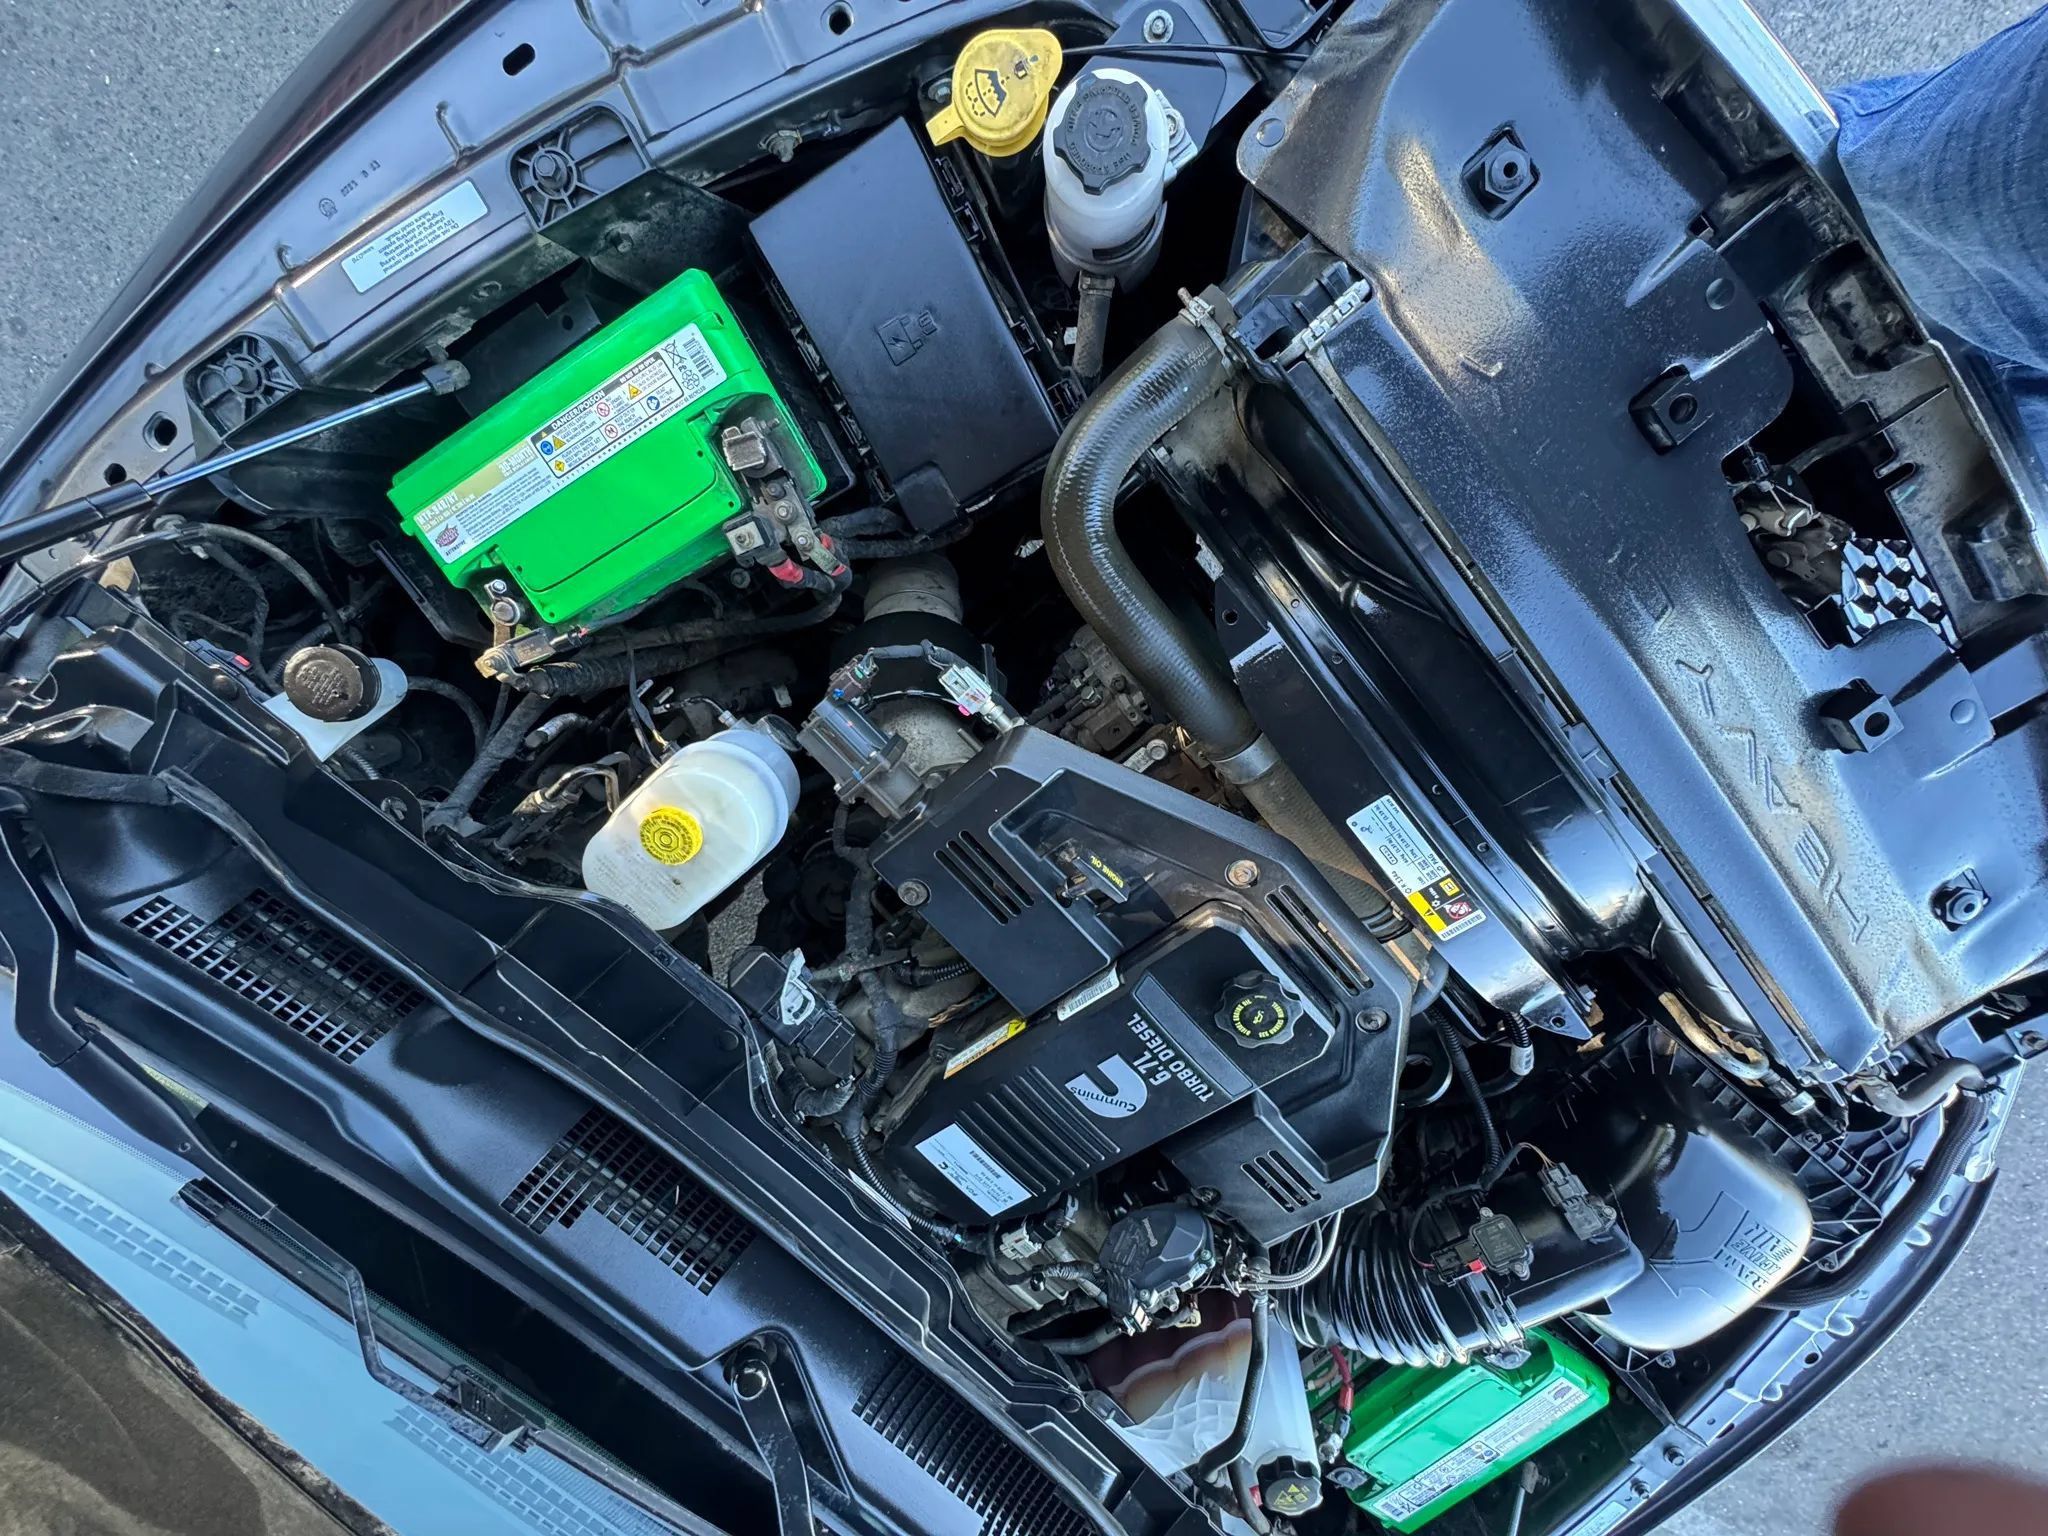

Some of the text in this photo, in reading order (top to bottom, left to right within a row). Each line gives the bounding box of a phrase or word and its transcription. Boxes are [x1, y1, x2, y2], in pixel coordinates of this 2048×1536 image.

[550, 390, 606, 429] DANGER/POISON
[1127, 1012, 1215, 1103] TURBO DIESEL
[1132, 1050, 1172, 1086] 6.7L
[1070, 1086, 1137, 1113] Cummins
[1730, 1239, 1782, 1276] ACTIVE
